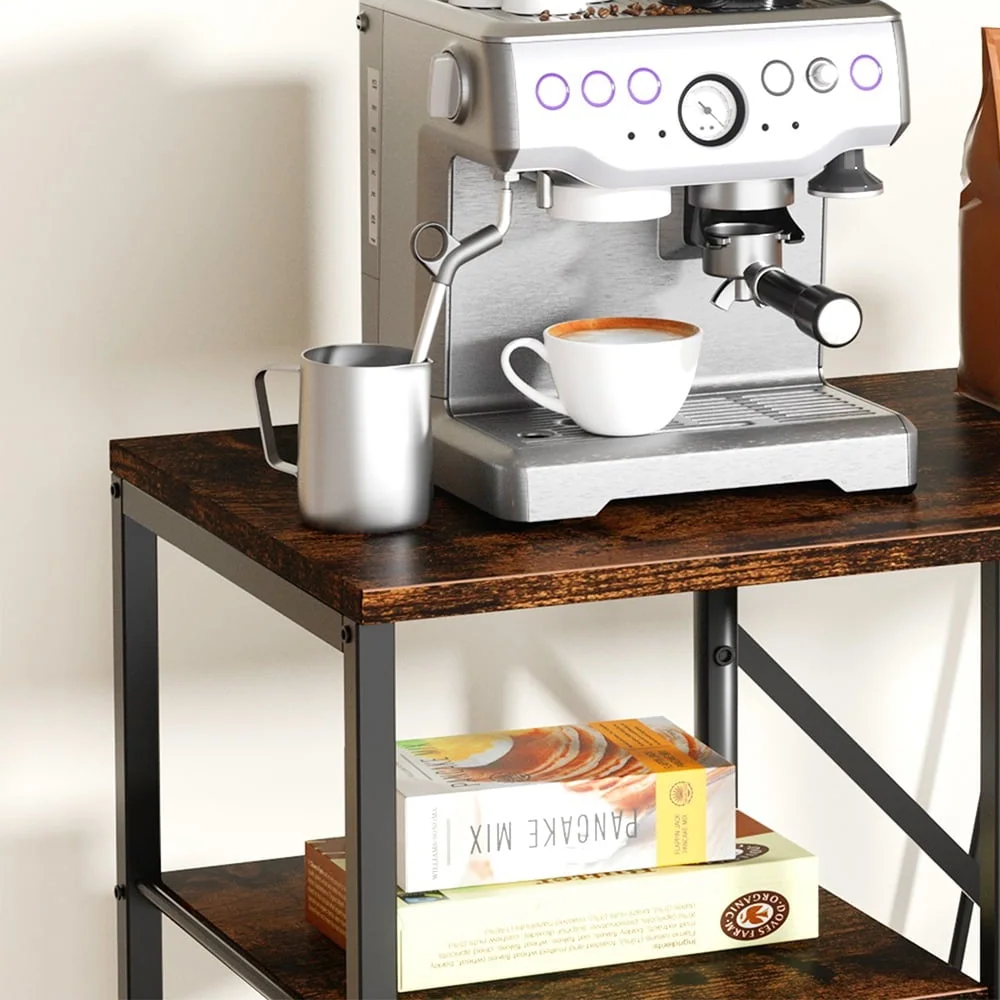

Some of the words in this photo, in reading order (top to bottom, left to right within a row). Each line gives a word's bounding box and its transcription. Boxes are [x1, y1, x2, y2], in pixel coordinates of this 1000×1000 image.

[469, 822, 512, 854] MIX
[527, 808, 638, 848] PANCAKE
[725, 893, 779, 918] ORGANIC
[758, 904, 786, 936] DOVES
[725, 921, 754, 938] FARM
